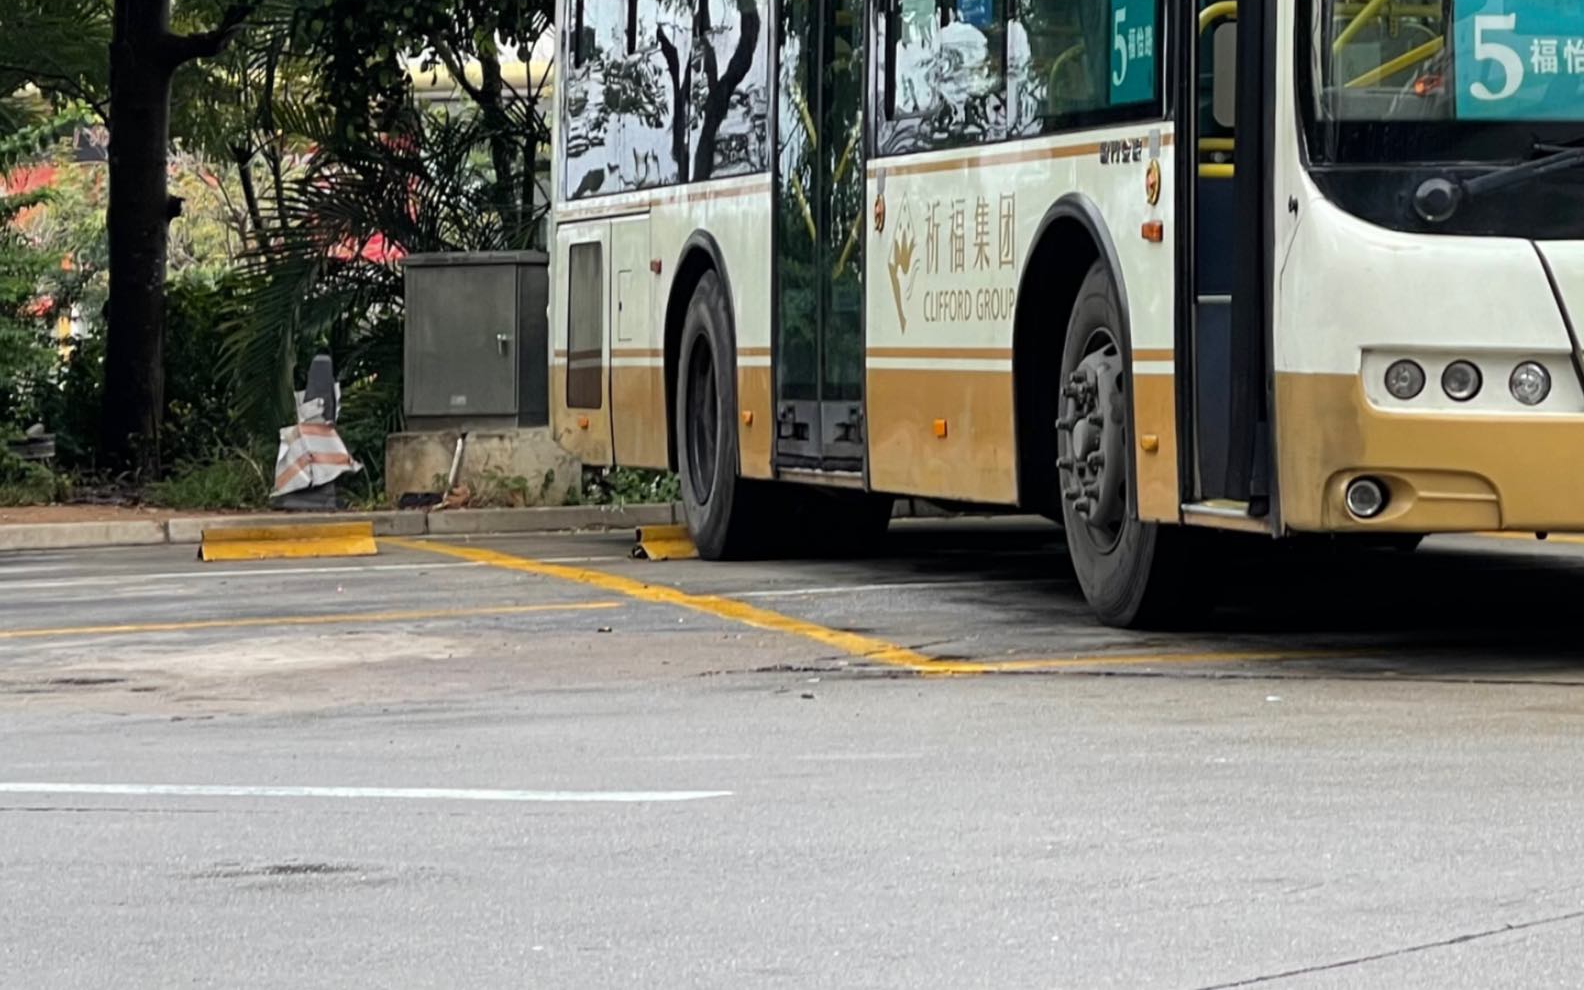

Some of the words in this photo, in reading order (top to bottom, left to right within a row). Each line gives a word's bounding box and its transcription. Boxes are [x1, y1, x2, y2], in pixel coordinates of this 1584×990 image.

[1112, 6, 1127, 86] 5
[1469, 12, 1525, 101] 5
[925, 191, 1015, 274] 祈福集团
[923, 290, 972, 322] CLIFFORD
[976, 287, 1015, 322] GROUP
